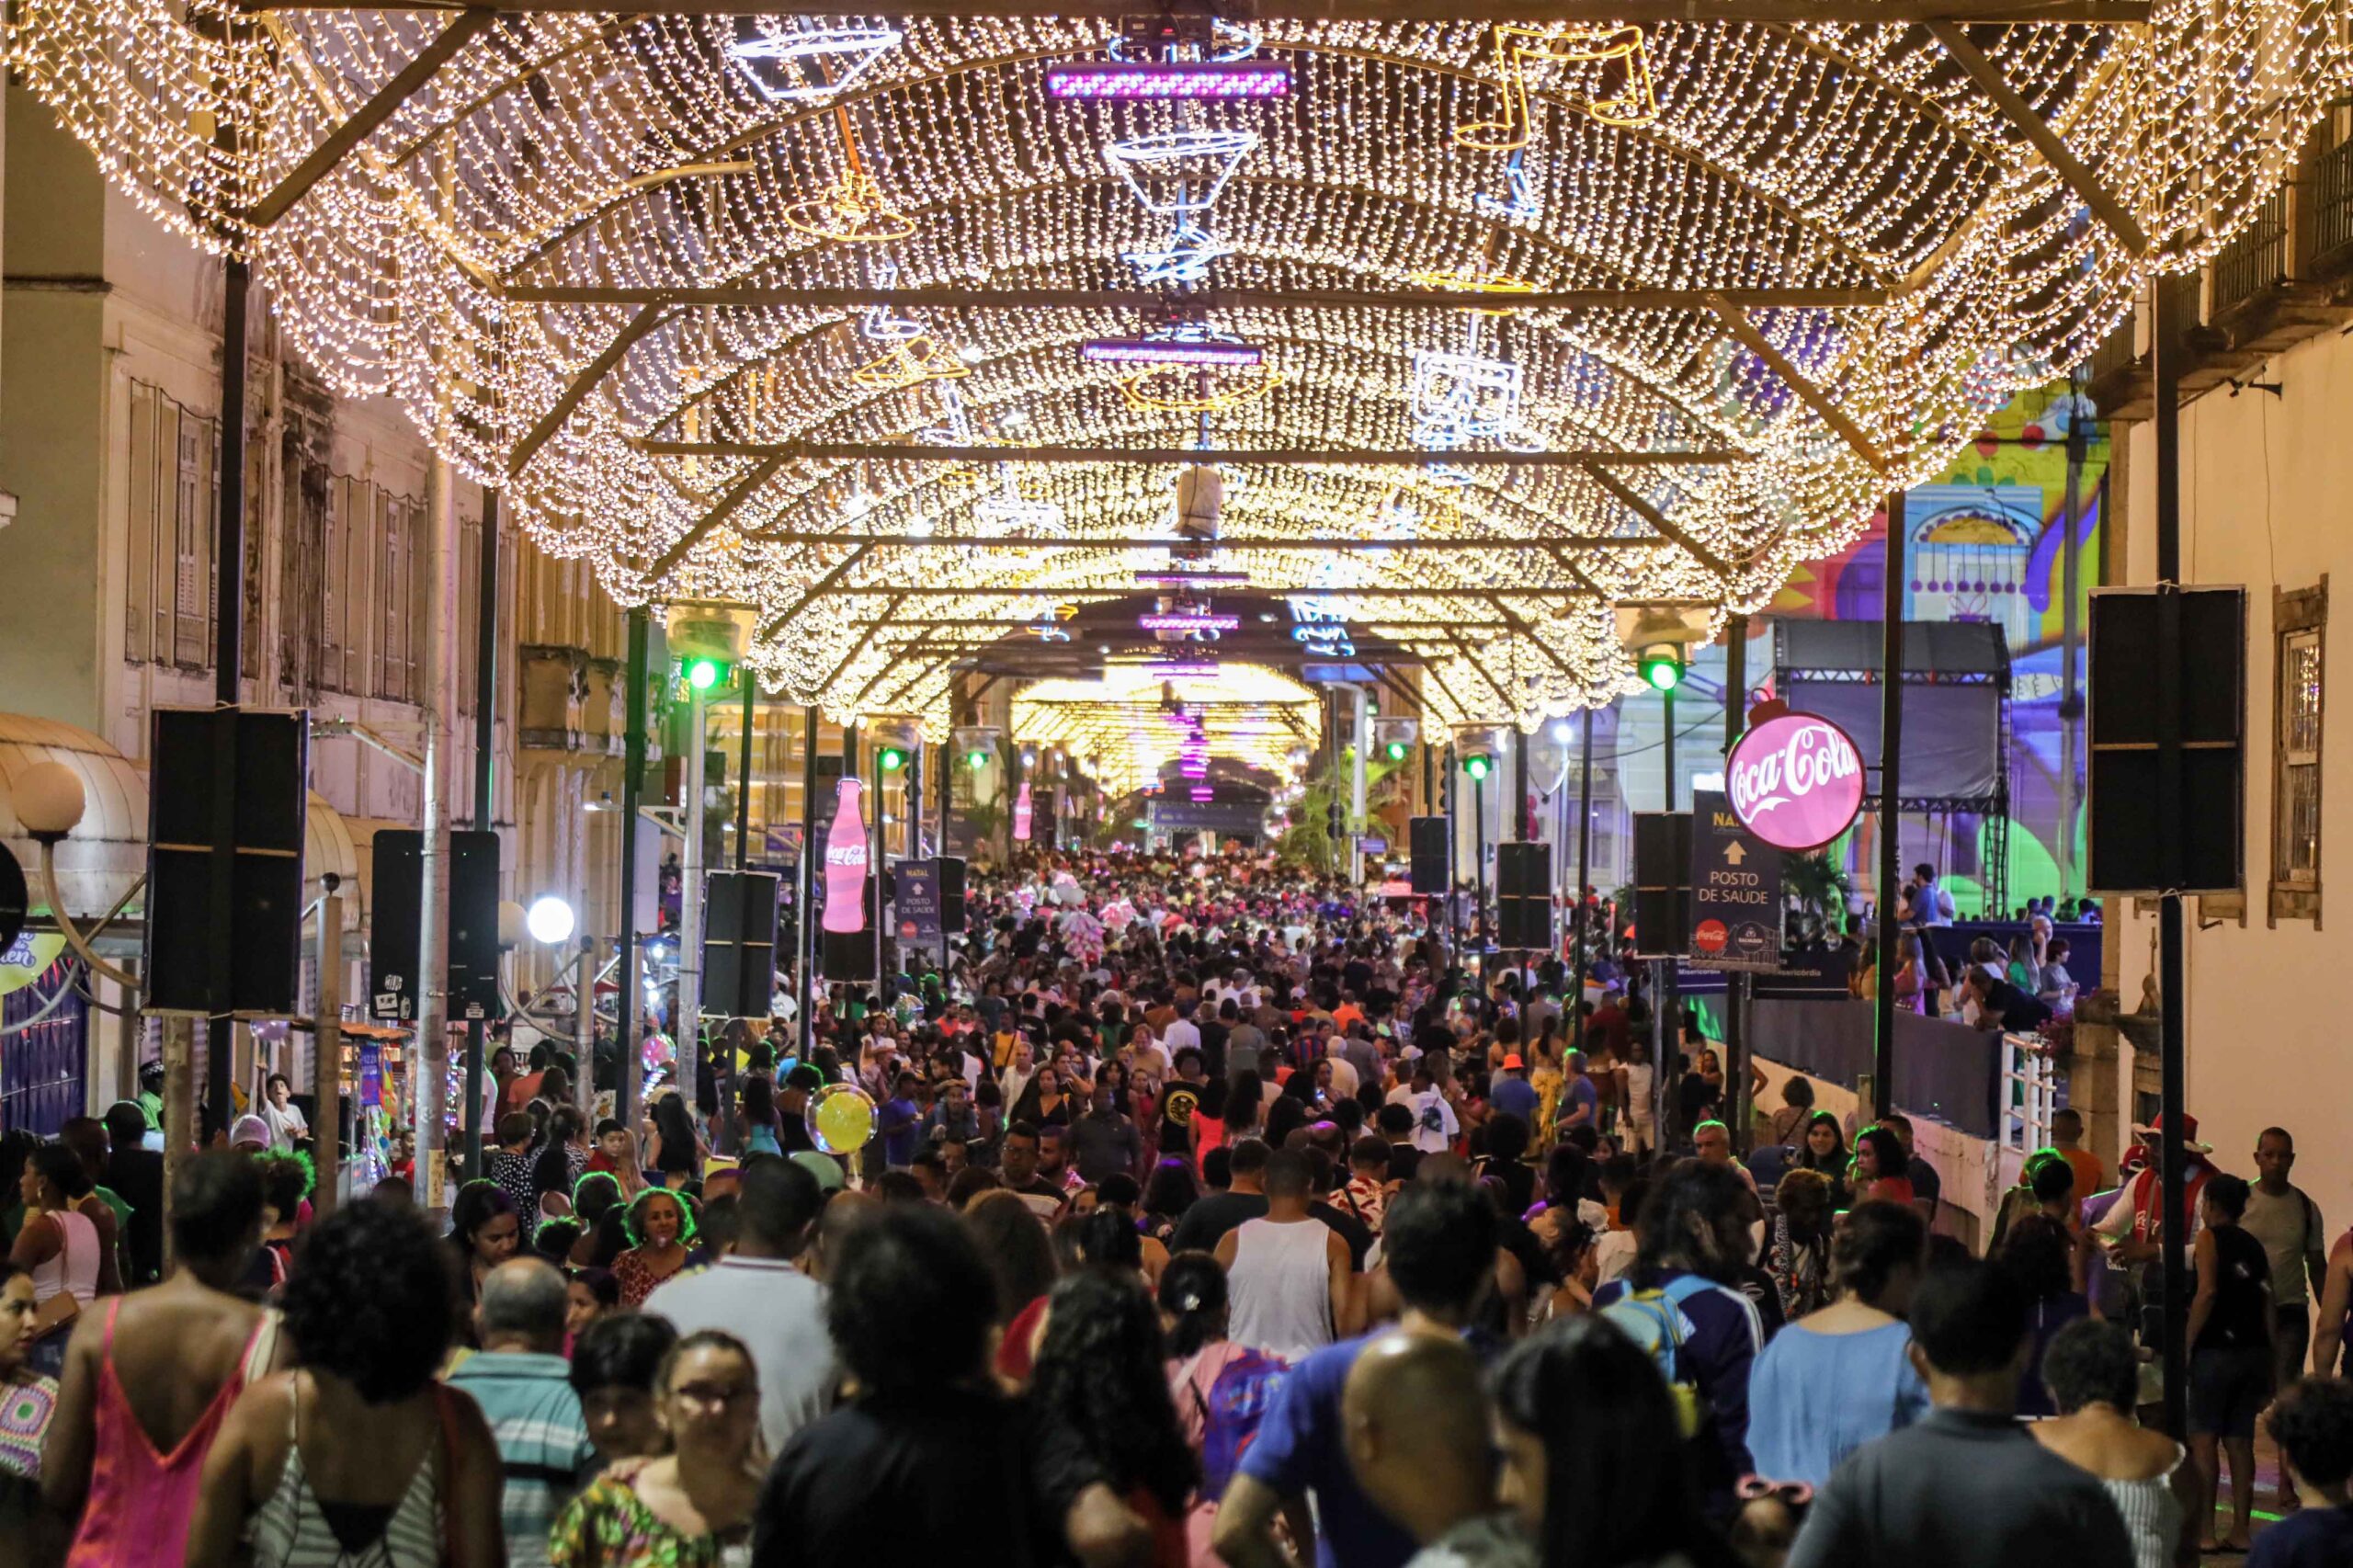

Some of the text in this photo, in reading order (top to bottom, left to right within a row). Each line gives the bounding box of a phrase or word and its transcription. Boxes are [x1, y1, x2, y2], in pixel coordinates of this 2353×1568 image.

[1730, 724, 1859, 824] Coca-Cola
[1711, 871, 1758, 886] POSTO
[1699, 888, 1768, 904] DE SAÚDE
